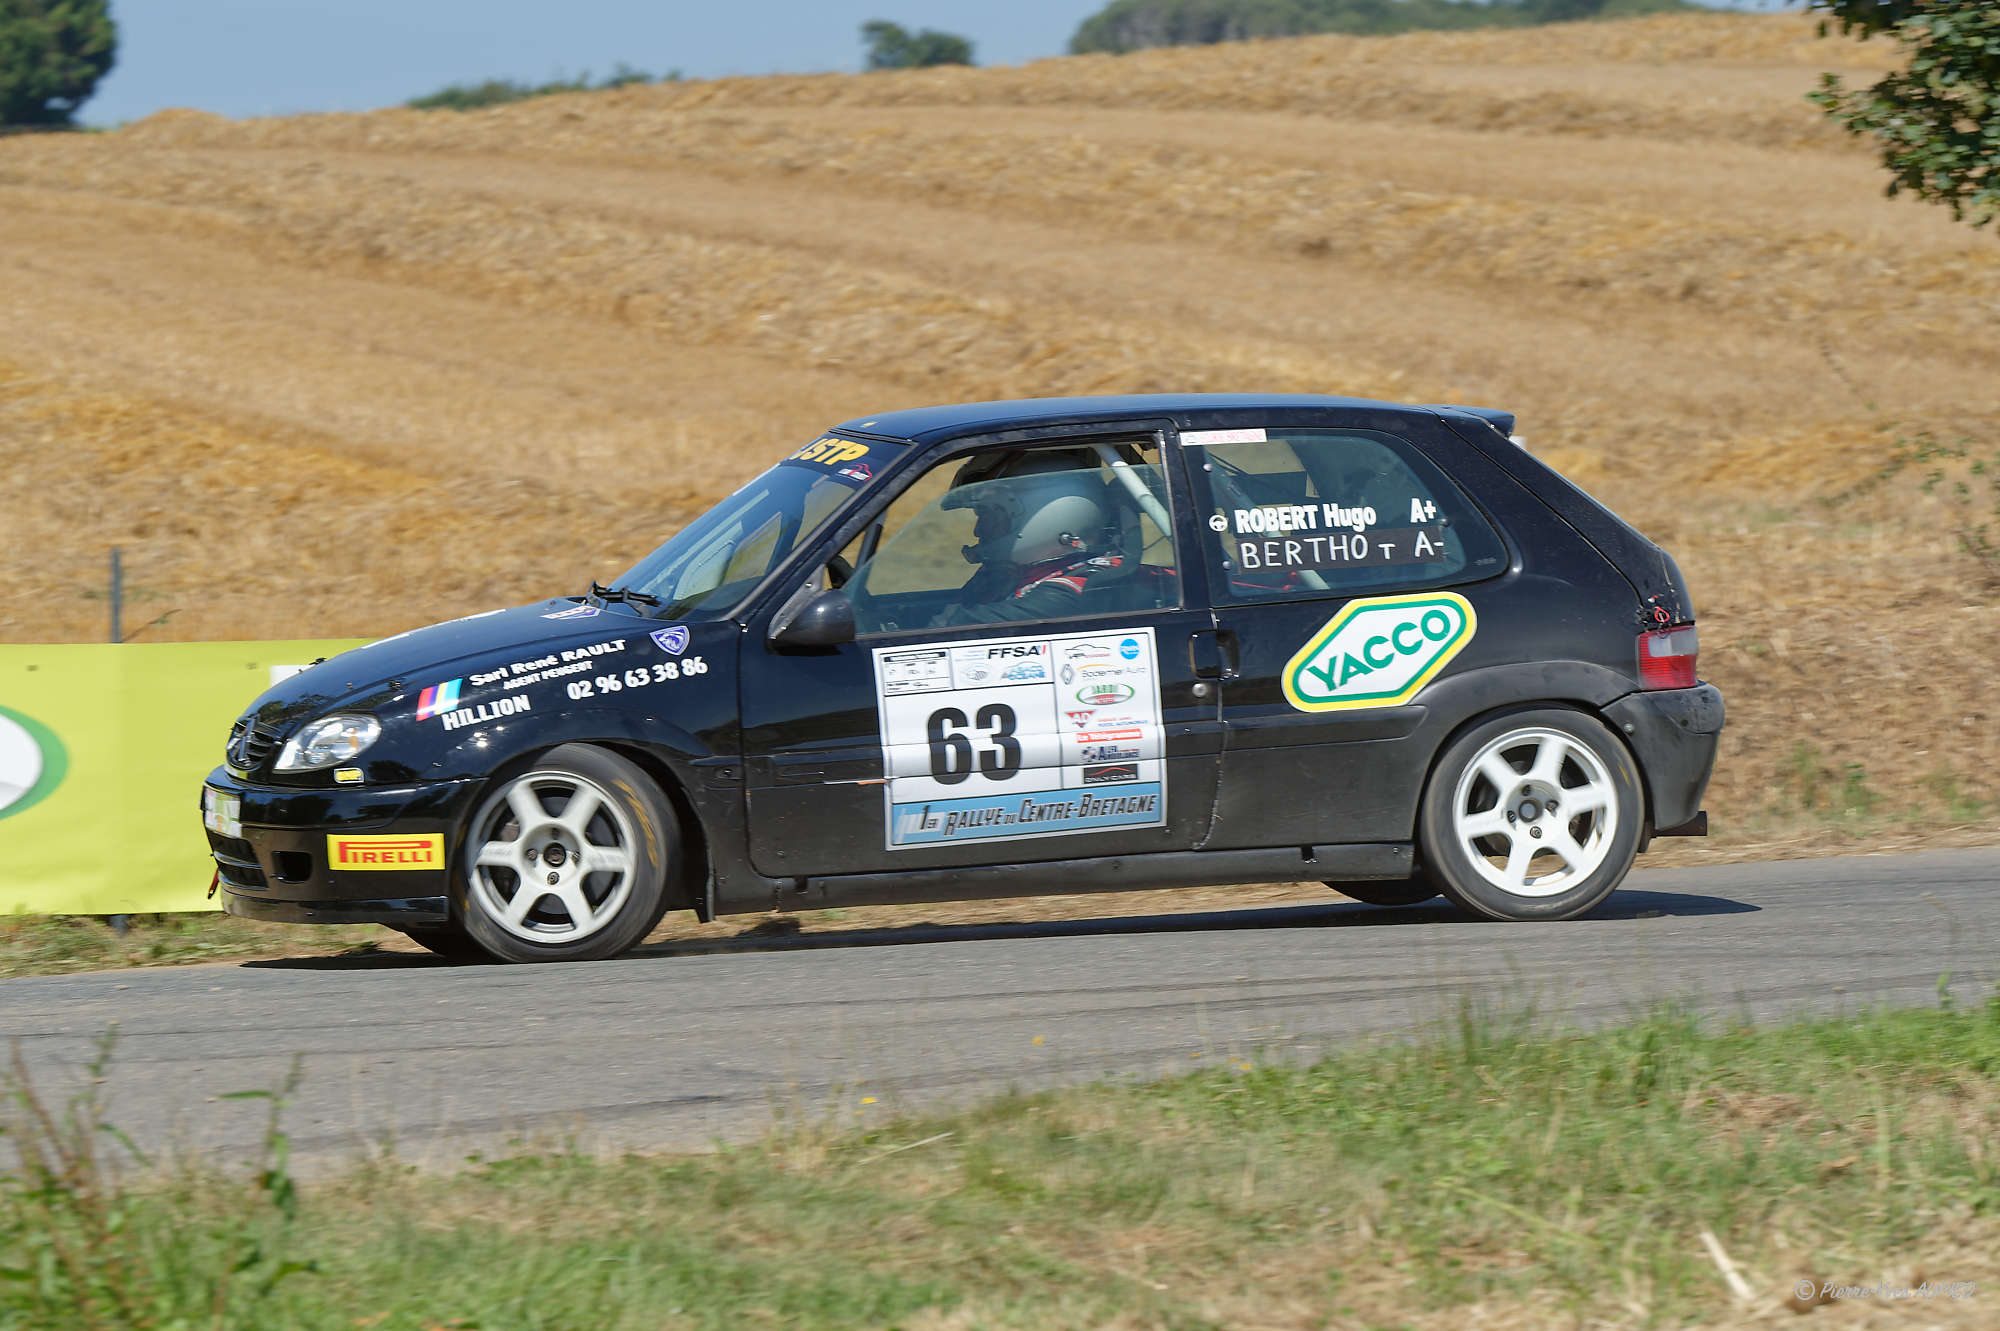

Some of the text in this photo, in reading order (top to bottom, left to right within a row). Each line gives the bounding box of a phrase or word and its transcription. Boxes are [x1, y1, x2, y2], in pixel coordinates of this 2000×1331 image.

[1234, 503, 1377, 534] ROBERT Hugo
[1410, 498, 1437, 523] A+
[469, 639, 626, 686] Sarl René RAULT
[988, 645, 1042, 659] FFSA
[1306, 609, 1451, 692] YACCO
[503, 673, 540, 690] AGENT
[566, 656, 708, 700] 02 96 63 38 86
[441, 694, 531, 731] HILLION
[927, 703, 1021, 785] 63
[944, 808, 1004, 836] RALLYE
[1016, 793, 1159, 824] CENTRE-BRETAGNE
[338, 841, 433, 863] PIRELLI
